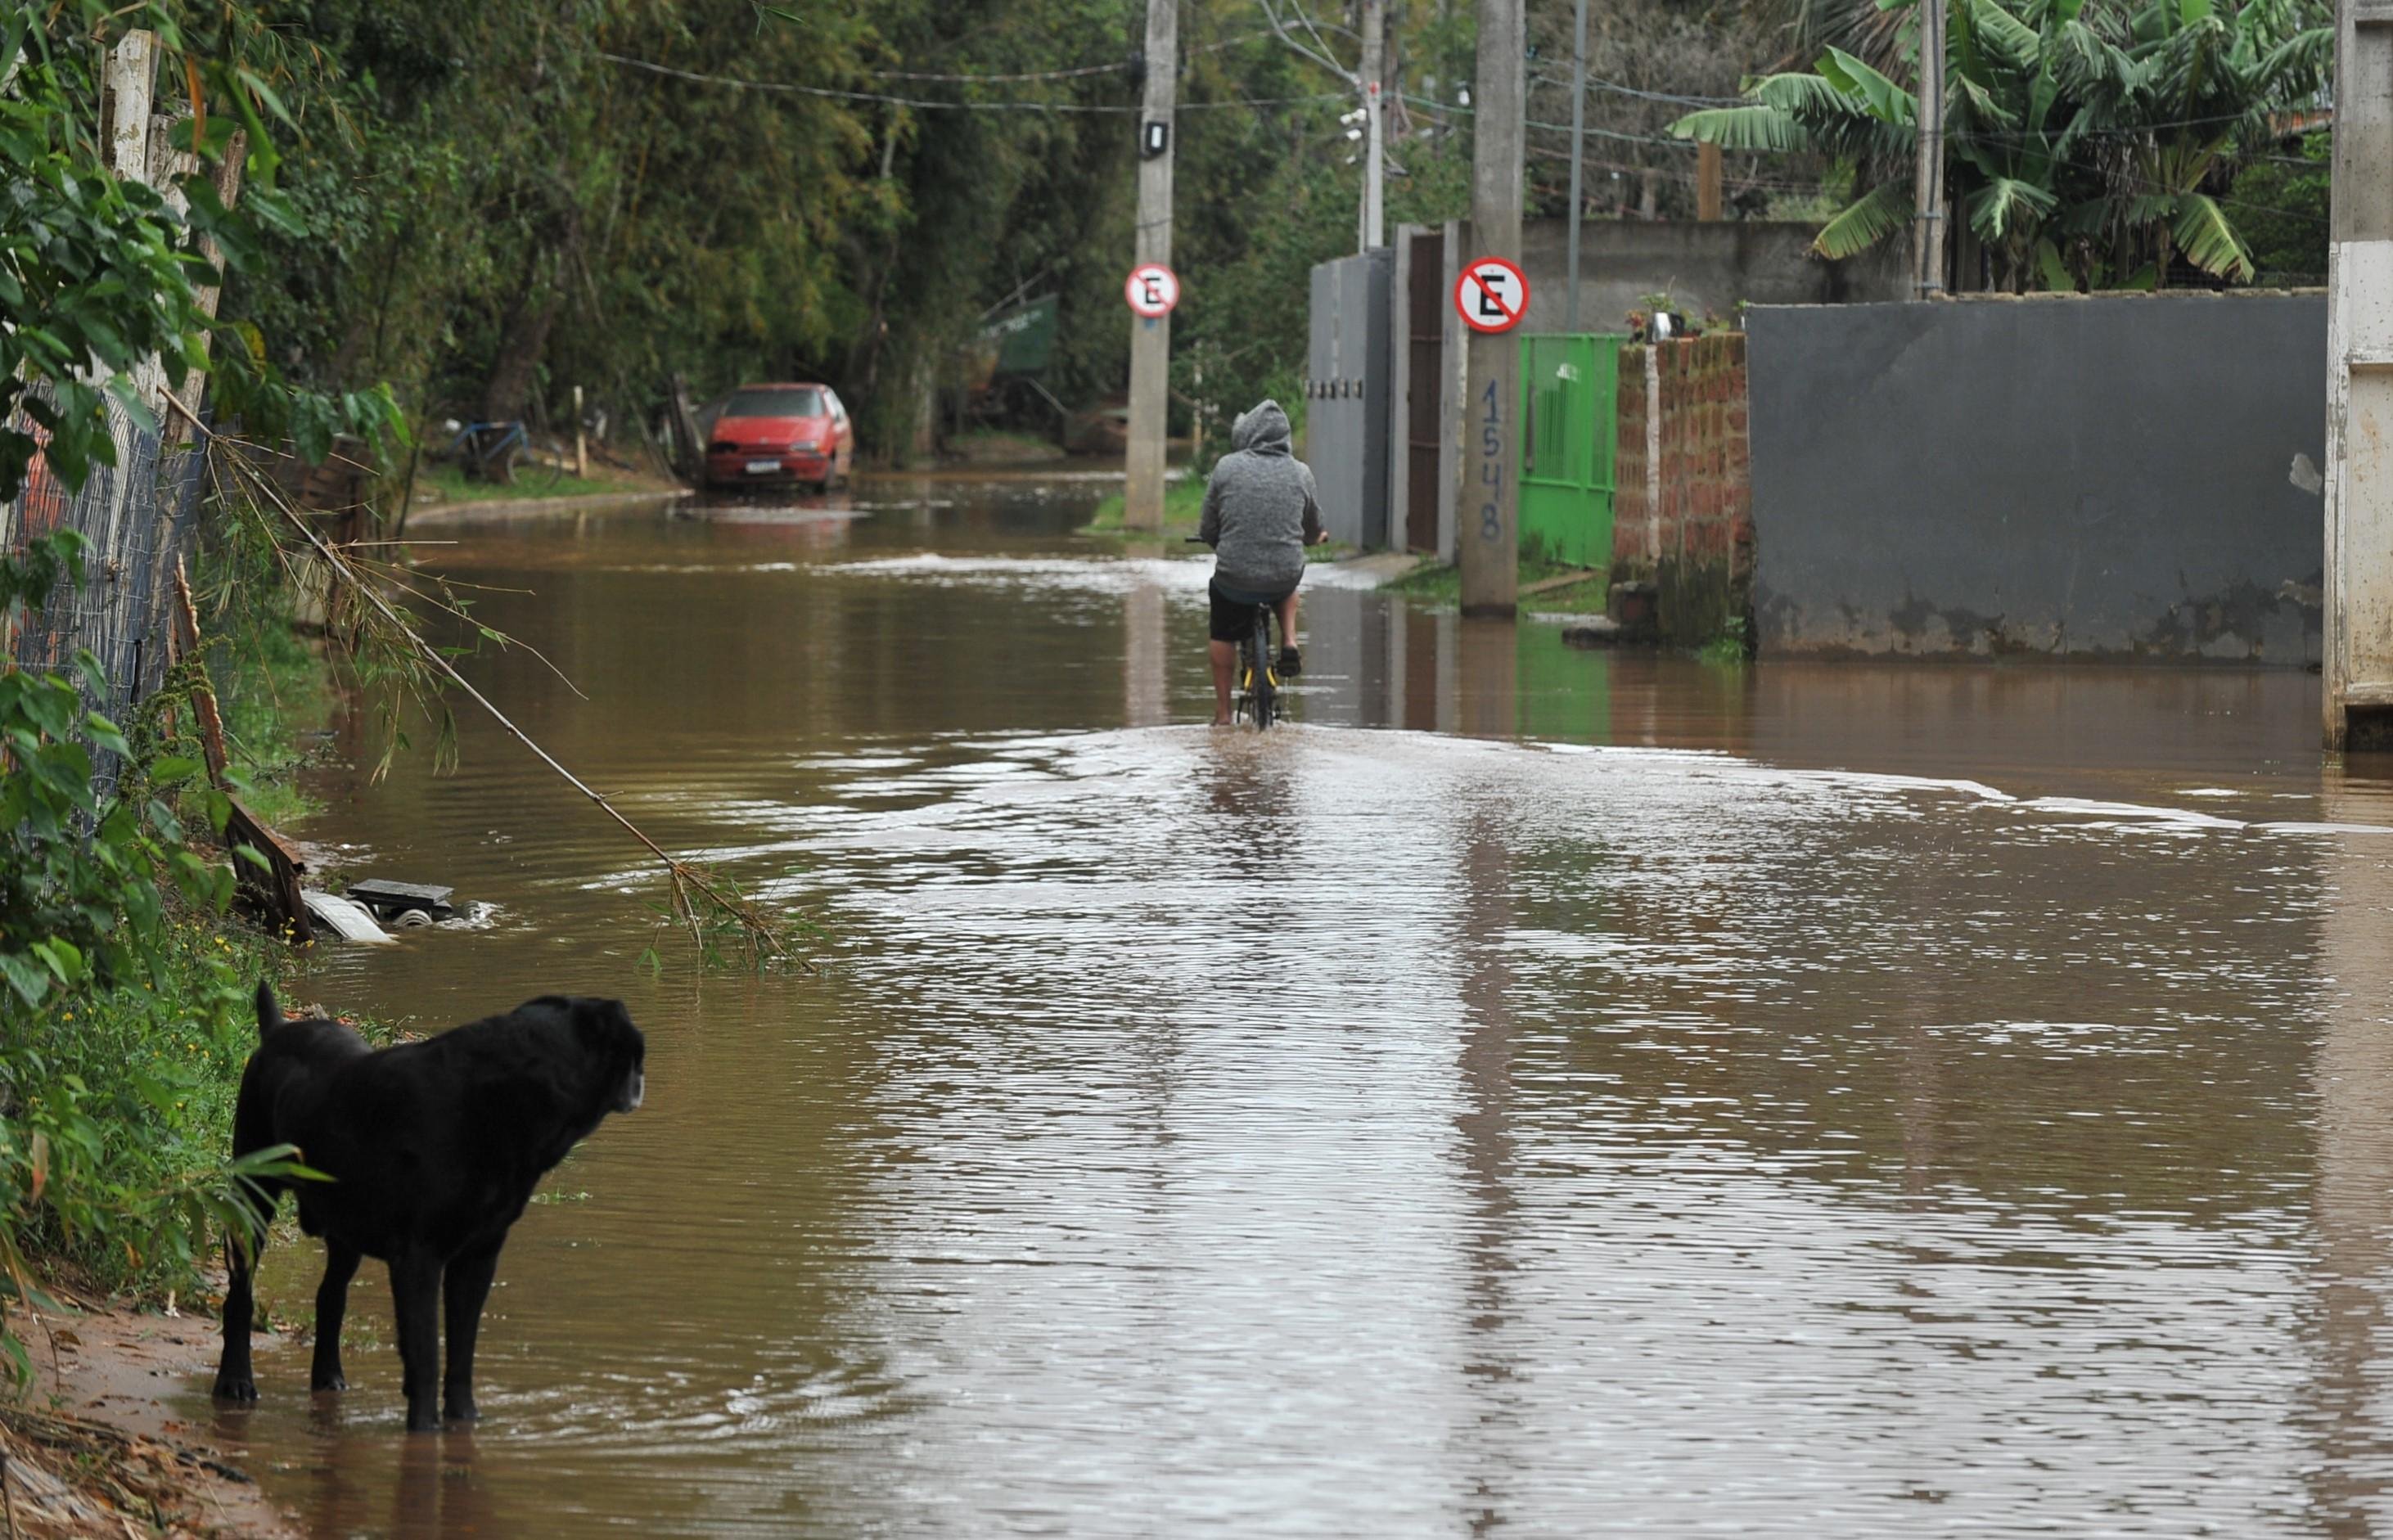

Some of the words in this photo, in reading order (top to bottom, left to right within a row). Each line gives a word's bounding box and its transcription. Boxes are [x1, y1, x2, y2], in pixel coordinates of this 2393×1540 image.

[1145, 277, 1161, 304] E
[1480, 275, 1505, 316] E
[1482, 379, 1502, 543] 1548
